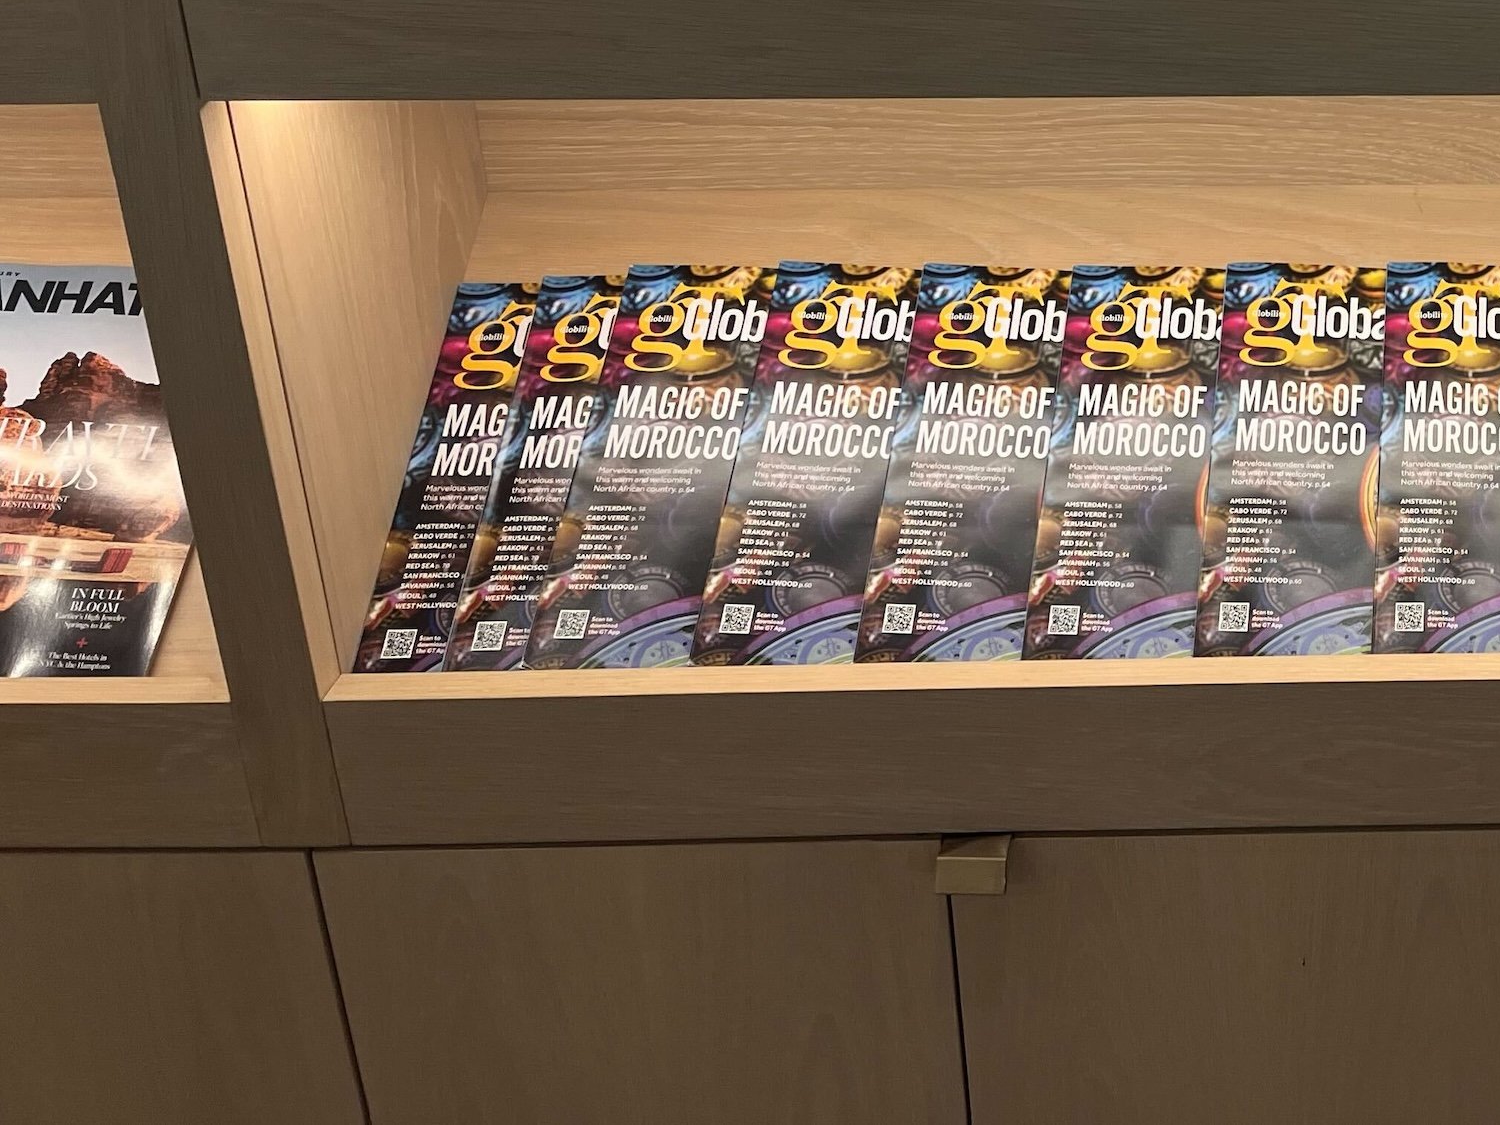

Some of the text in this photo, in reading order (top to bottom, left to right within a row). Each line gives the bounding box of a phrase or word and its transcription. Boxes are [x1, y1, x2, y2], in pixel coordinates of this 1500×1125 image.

[529, 395, 593, 430] MAG
[613, 384, 749, 421] MAGIC OF
[770, 381, 901, 420] MAGIC OF
[922, 381, 1055, 420] MAGIC OF
[1078, 383, 1208, 418] MAGIC OF
[1238, 379, 1366, 417] MAGIC OF
[1404, 380, 1490, 417] MAGIC
[603, 424, 741, 461] MOROCCO
[915, 420, 1050, 460] MOROCCO
[1072, 421, 1206, 458] MOROCCO
[1235, 418, 1366, 456] MOROCCO
[431, 442, 497, 476] MOR
[1232, 459, 1271, 467] Marvelous
[1285, 471, 1326, 480] welcoming
[70, 601, 119, 613] BLOOM
[71, 588, 125, 600] IN FULL
